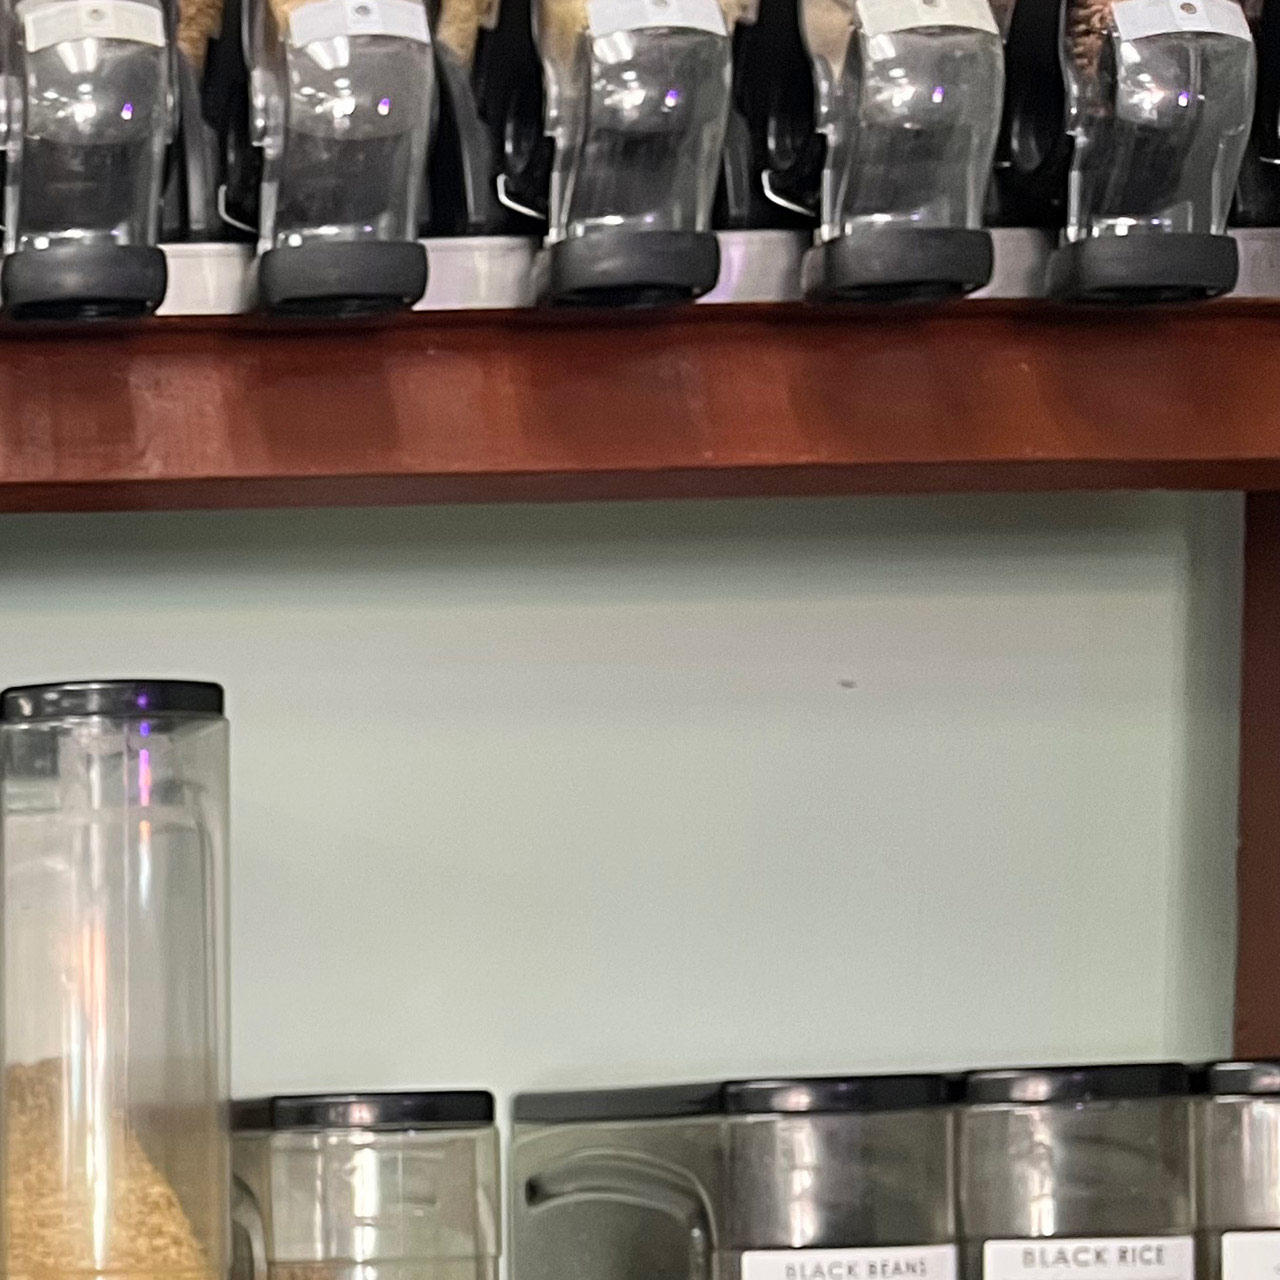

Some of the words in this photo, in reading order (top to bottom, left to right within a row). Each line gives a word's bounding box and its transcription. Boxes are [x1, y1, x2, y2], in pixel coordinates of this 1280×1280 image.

[1022, 1246, 1108, 1268] BLACK
[1117, 1245, 1165, 1266] RICE
[785, 1261, 859, 1280] BLACK
[868, 1258, 927, 1278] BEANS
